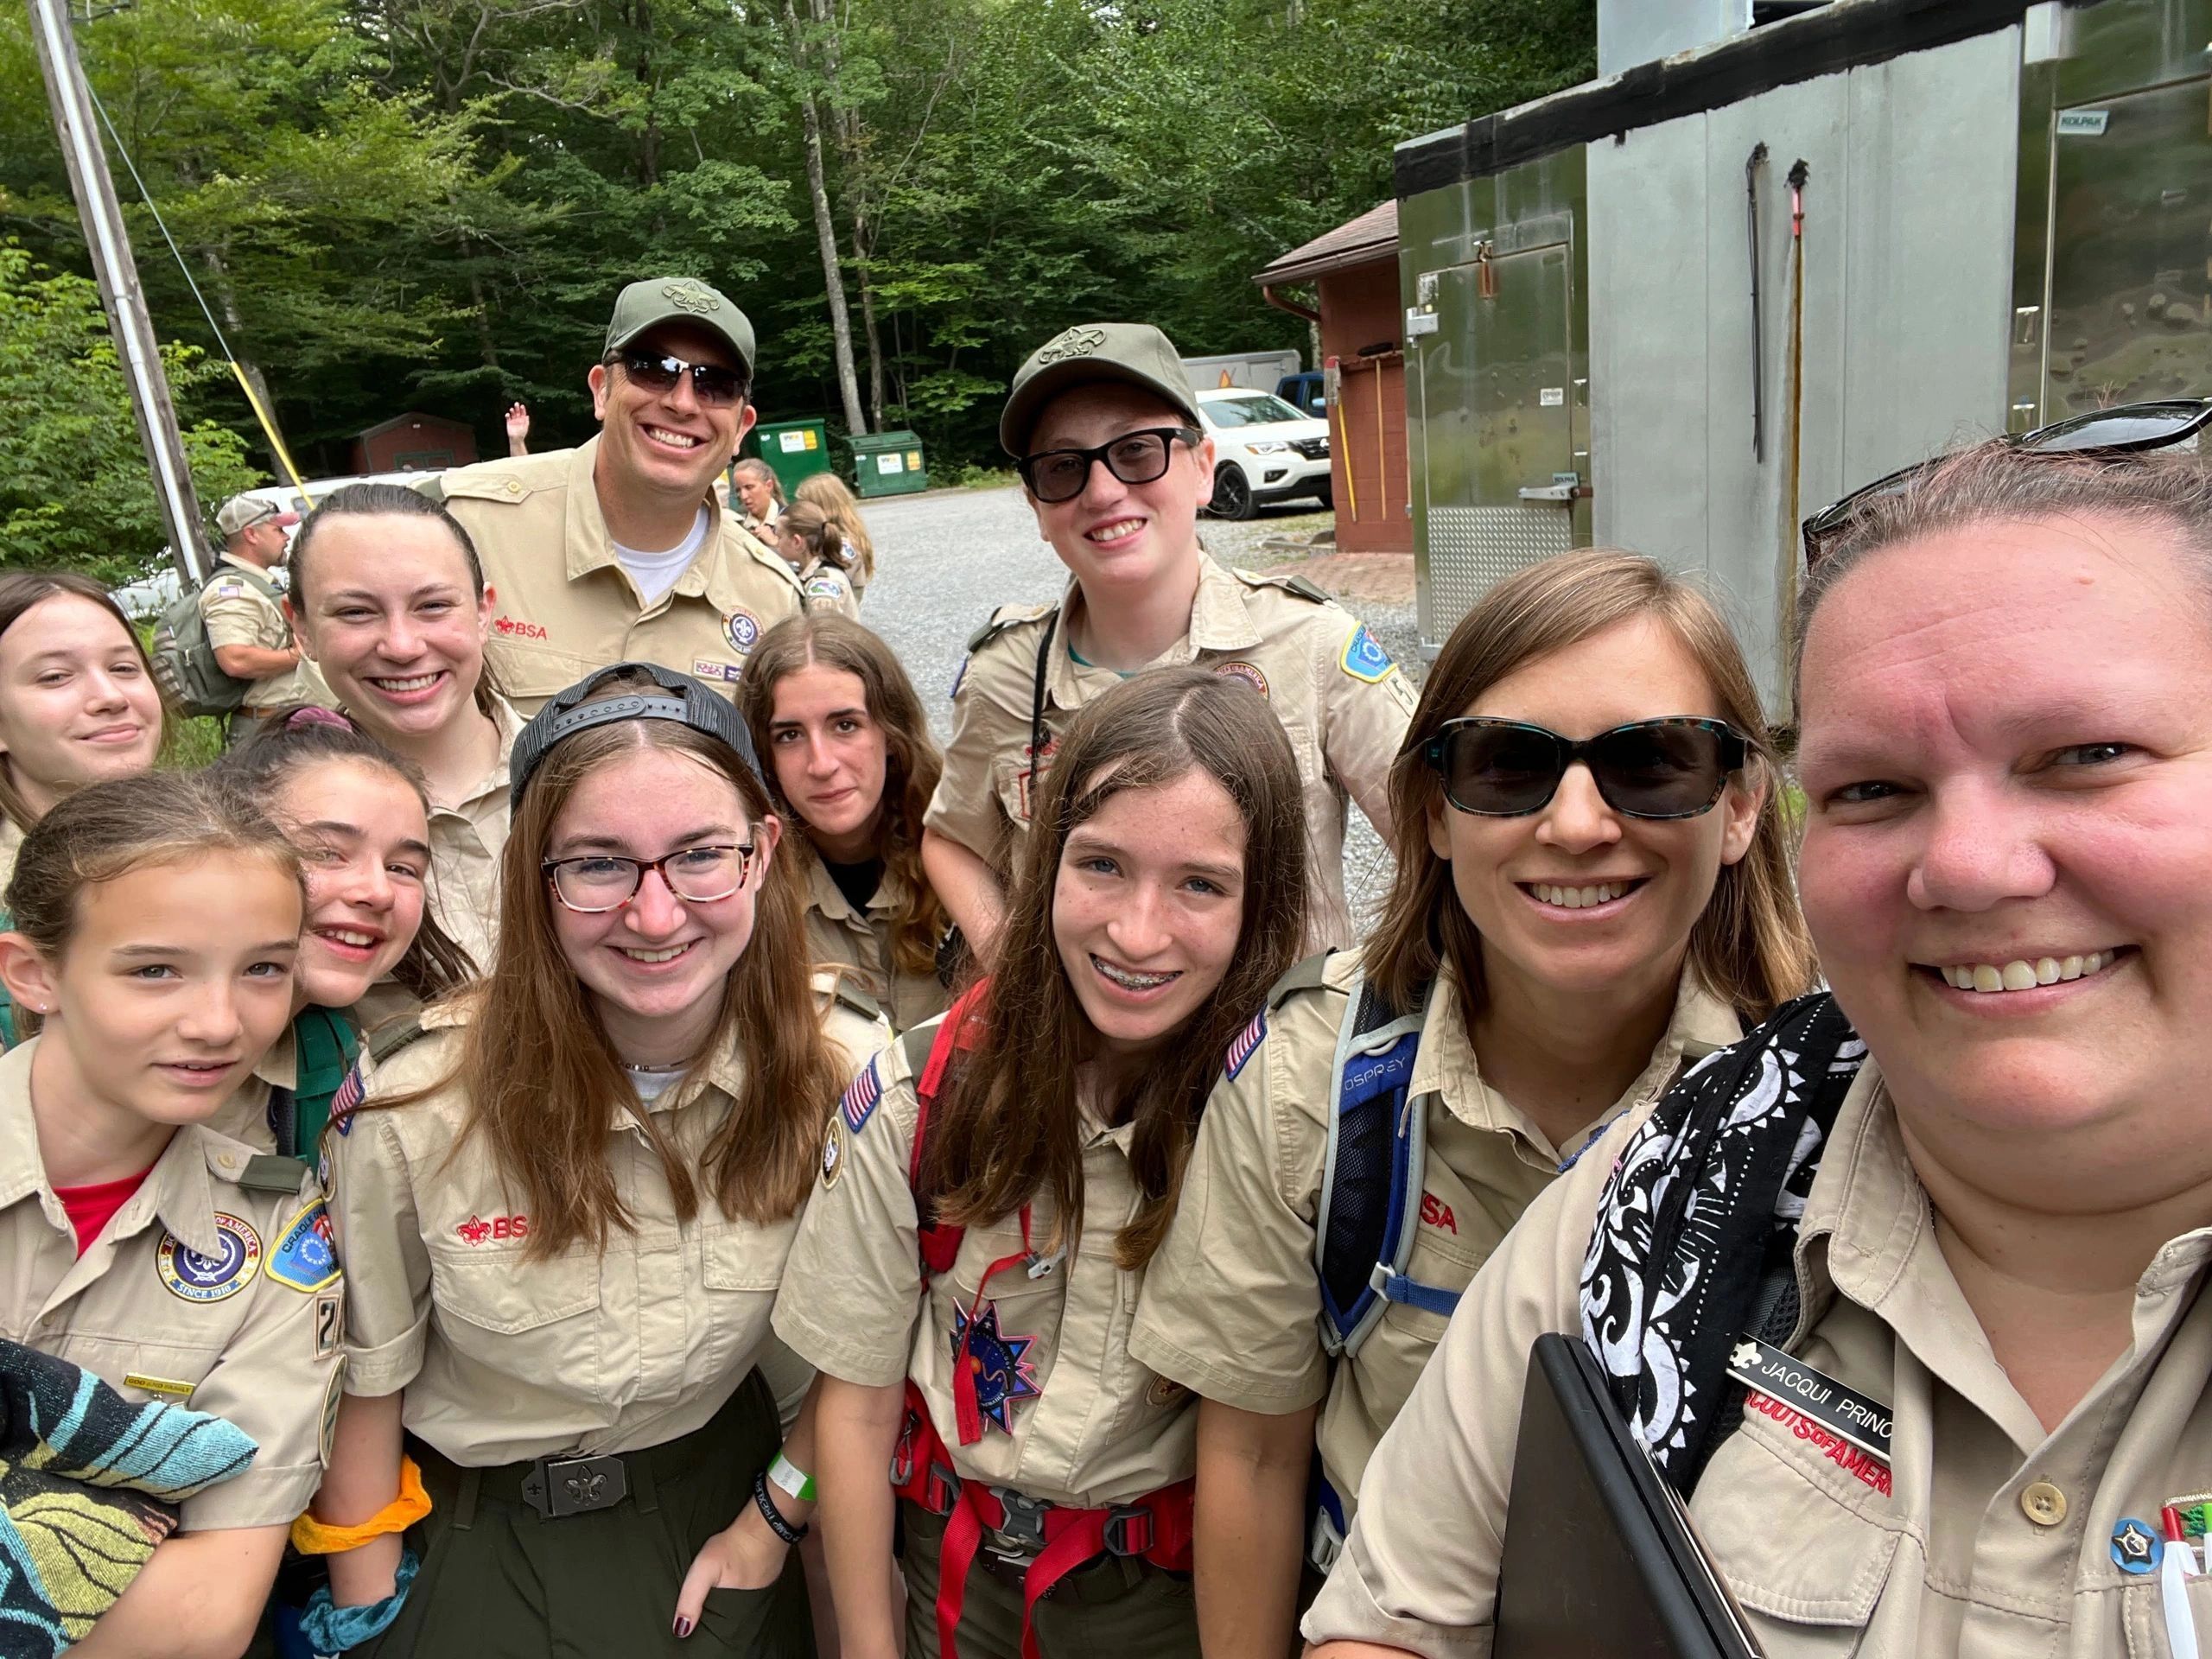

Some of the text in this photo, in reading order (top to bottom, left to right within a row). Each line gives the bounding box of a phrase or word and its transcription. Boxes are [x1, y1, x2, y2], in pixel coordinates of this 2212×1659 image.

[515, 621, 548, 641] BSA
[1344, 1056, 1407, 1092] OSPREY
[226, 1218, 257, 1253] AMERICA
[281, 1215, 315, 1254] CRADLE
[177, 1284, 232, 1299] SINCE 1910
[318, 1301, 335, 1350] 2
[1761, 1362, 1833, 1405] JACQUI
